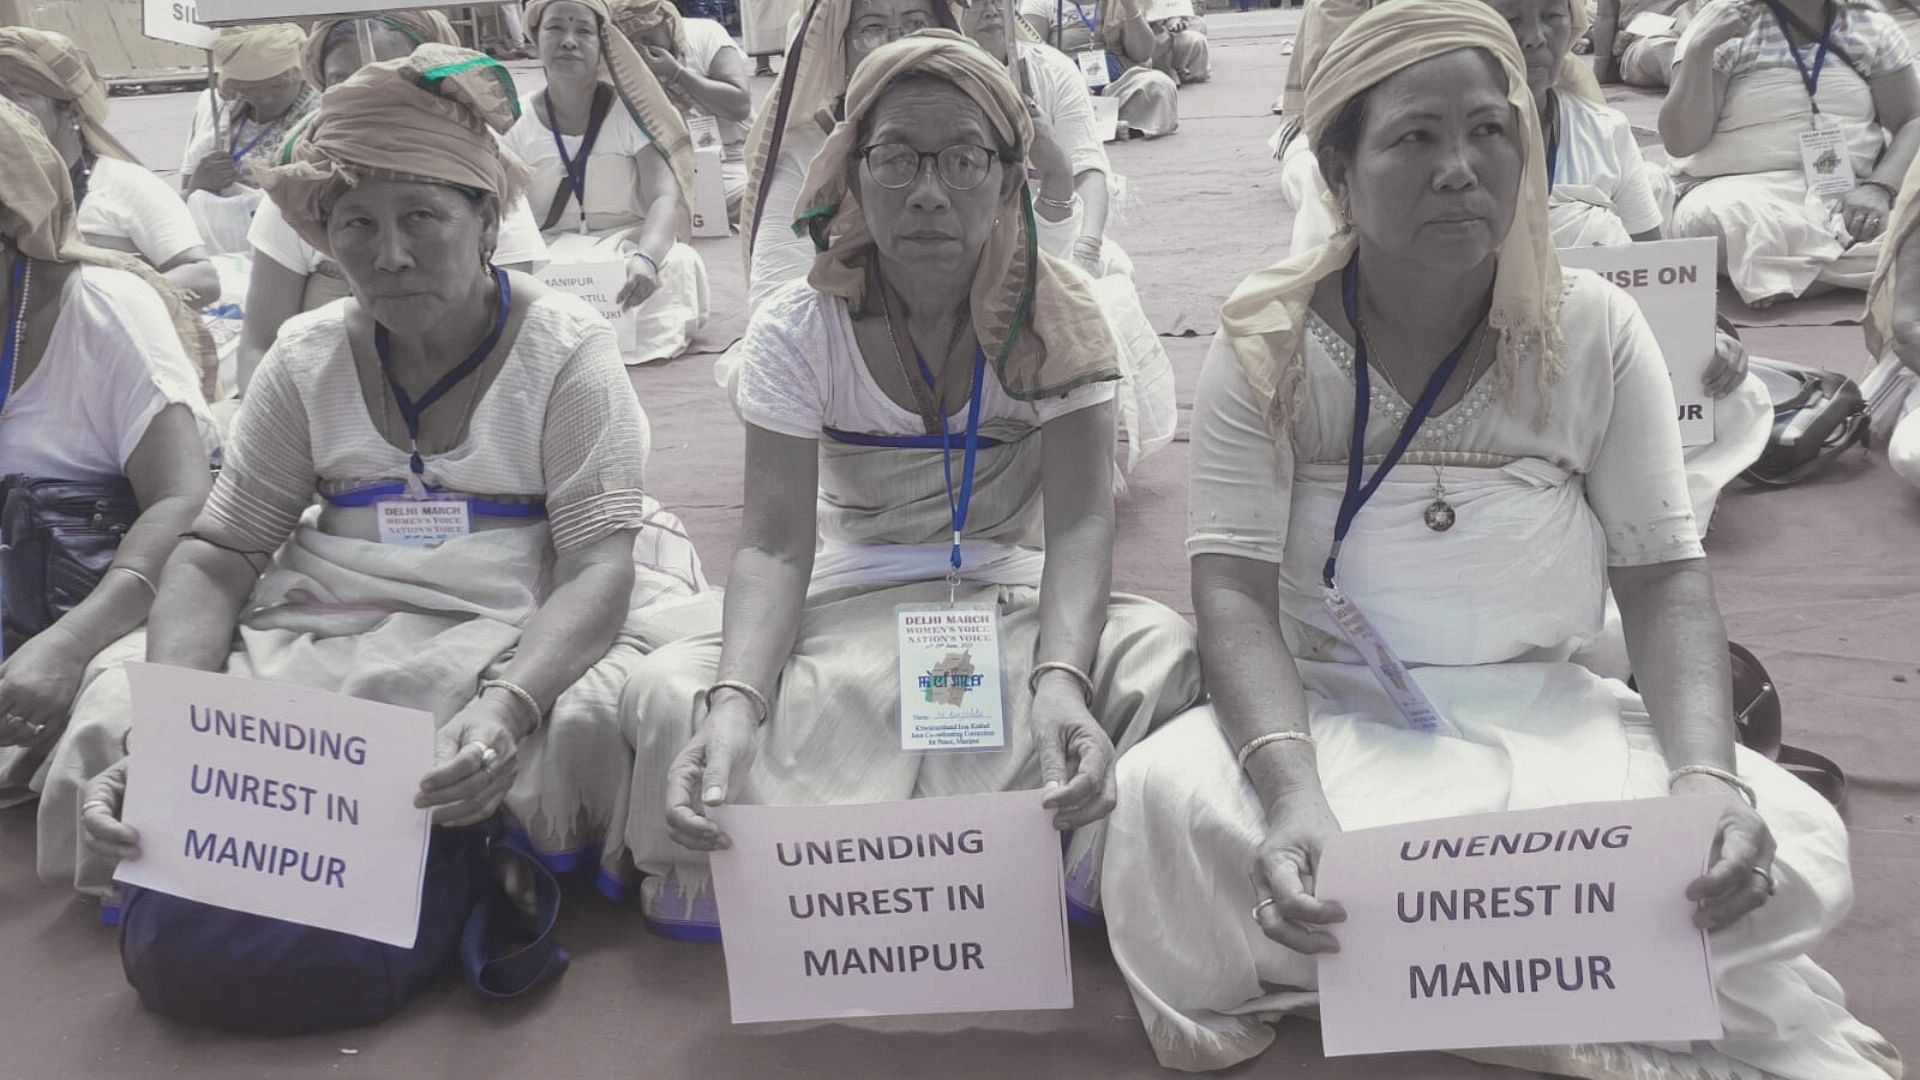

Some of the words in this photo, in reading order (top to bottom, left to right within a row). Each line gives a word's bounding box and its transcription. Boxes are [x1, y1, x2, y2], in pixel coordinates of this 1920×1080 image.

[1658, 265, 1697, 285] ON
[385, 507, 418, 516] DELHI
[422, 506, 461, 515] MARCH
[905, 616, 942, 625] DELHI
[946, 615, 990, 624] MARCH
[906, 626, 956, 634] WOMEN'S
[958, 625, 990, 633] VOICE
[908, 635, 956, 643] NATION'S
[959, 634, 991, 642] VOICE
[190, 704, 367, 765] UNENDING
[191, 763, 317, 815] UNREST
[327, 793, 359, 826] IN
[184, 828, 346, 888] MANIPUR
[776, 829, 984, 867] UNENDING
[1400, 825, 1633, 861] UNENDING
[788, 887, 935, 919] UNREST
[947, 884, 985, 911] IN
[1397, 884, 1561, 923] UNREST
[1574, 882, 1616, 914] IN
[804, 942, 985, 977] MANIPUR
[1409, 955, 1616, 999] MANIPUR
